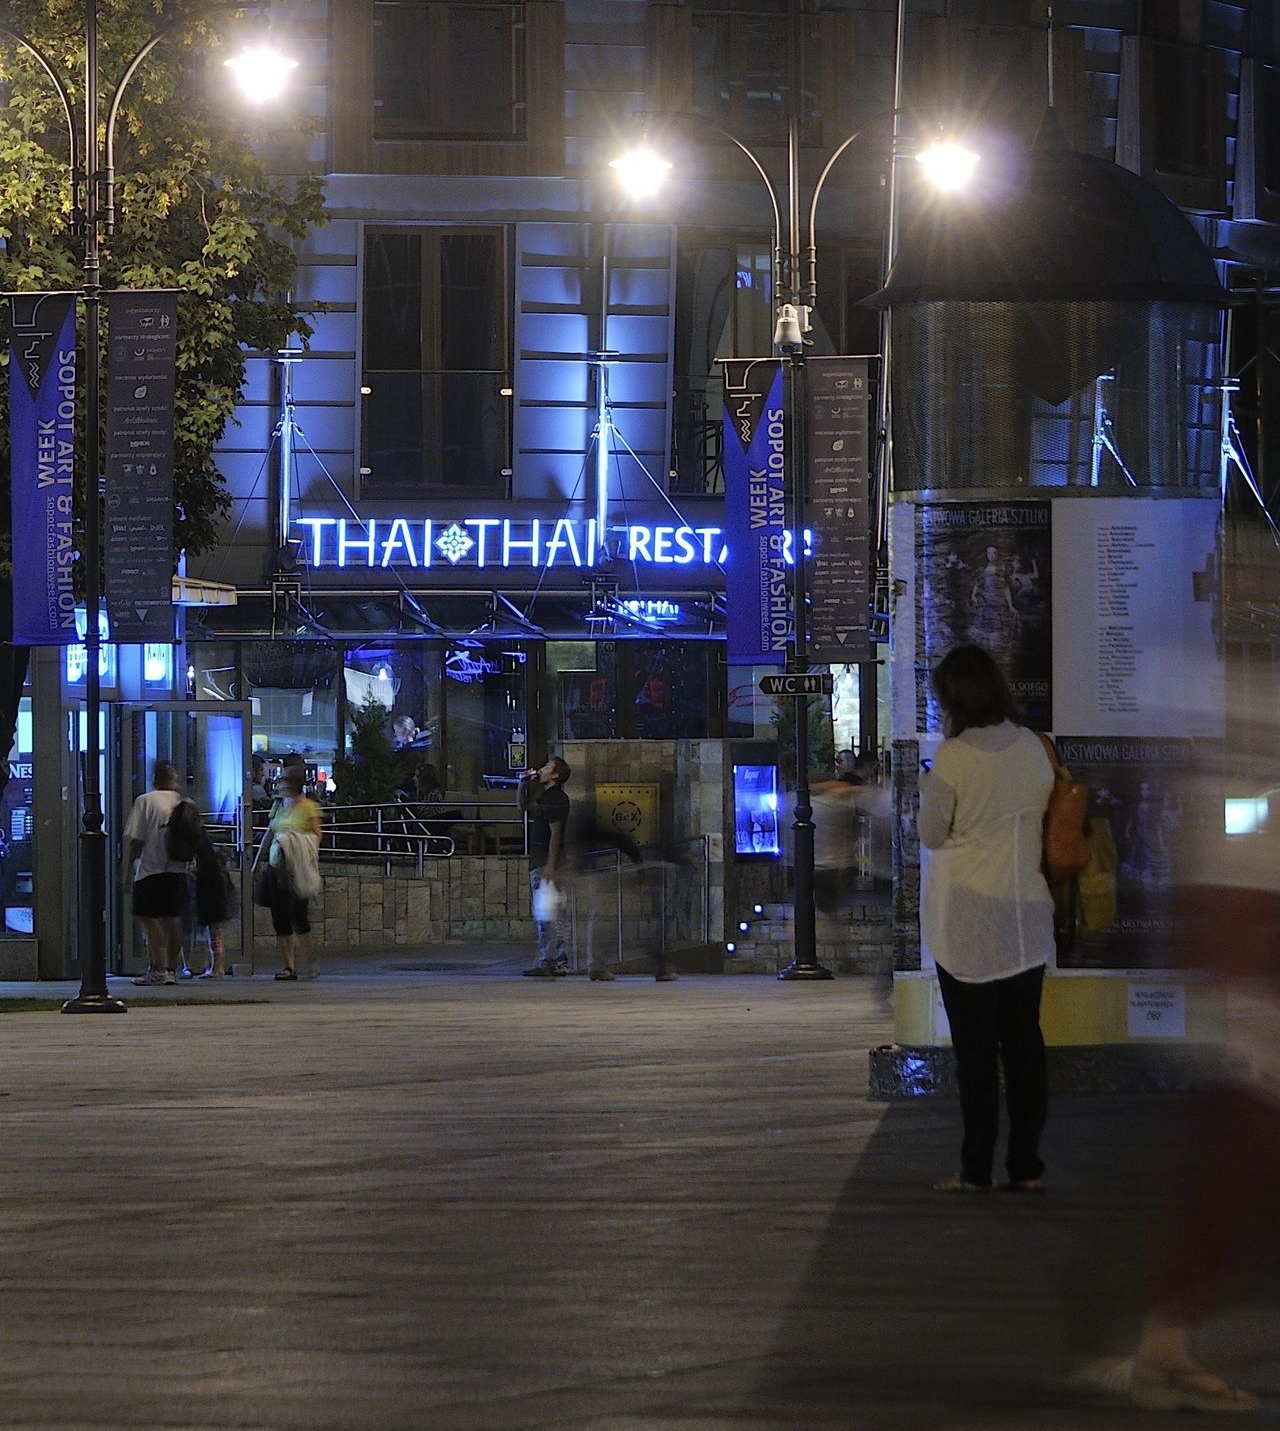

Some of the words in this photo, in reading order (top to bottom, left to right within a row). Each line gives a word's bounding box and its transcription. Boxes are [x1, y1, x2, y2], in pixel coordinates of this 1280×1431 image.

[57, 350, 77, 433] SOPOT
[37, 419, 56, 489] WEEK
[57, 439, 76, 490] ART
[767, 408, 784, 481] SOPOT
[56, 495, 74, 515] &
[749, 468, 767, 530] WEEK
[768, 488, 785, 528] ART
[1011, 508, 1048, 525] SZTUKI
[296, 517, 433, 568] THAI
[459, 517, 595, 568] THAI
[56, 524, 76, 630] FASHION
[770, 559, 786, 651] FASHION
[769, 677, 797, 693] WC
[1007, 681, 1049, 691] OLSKIEGO
